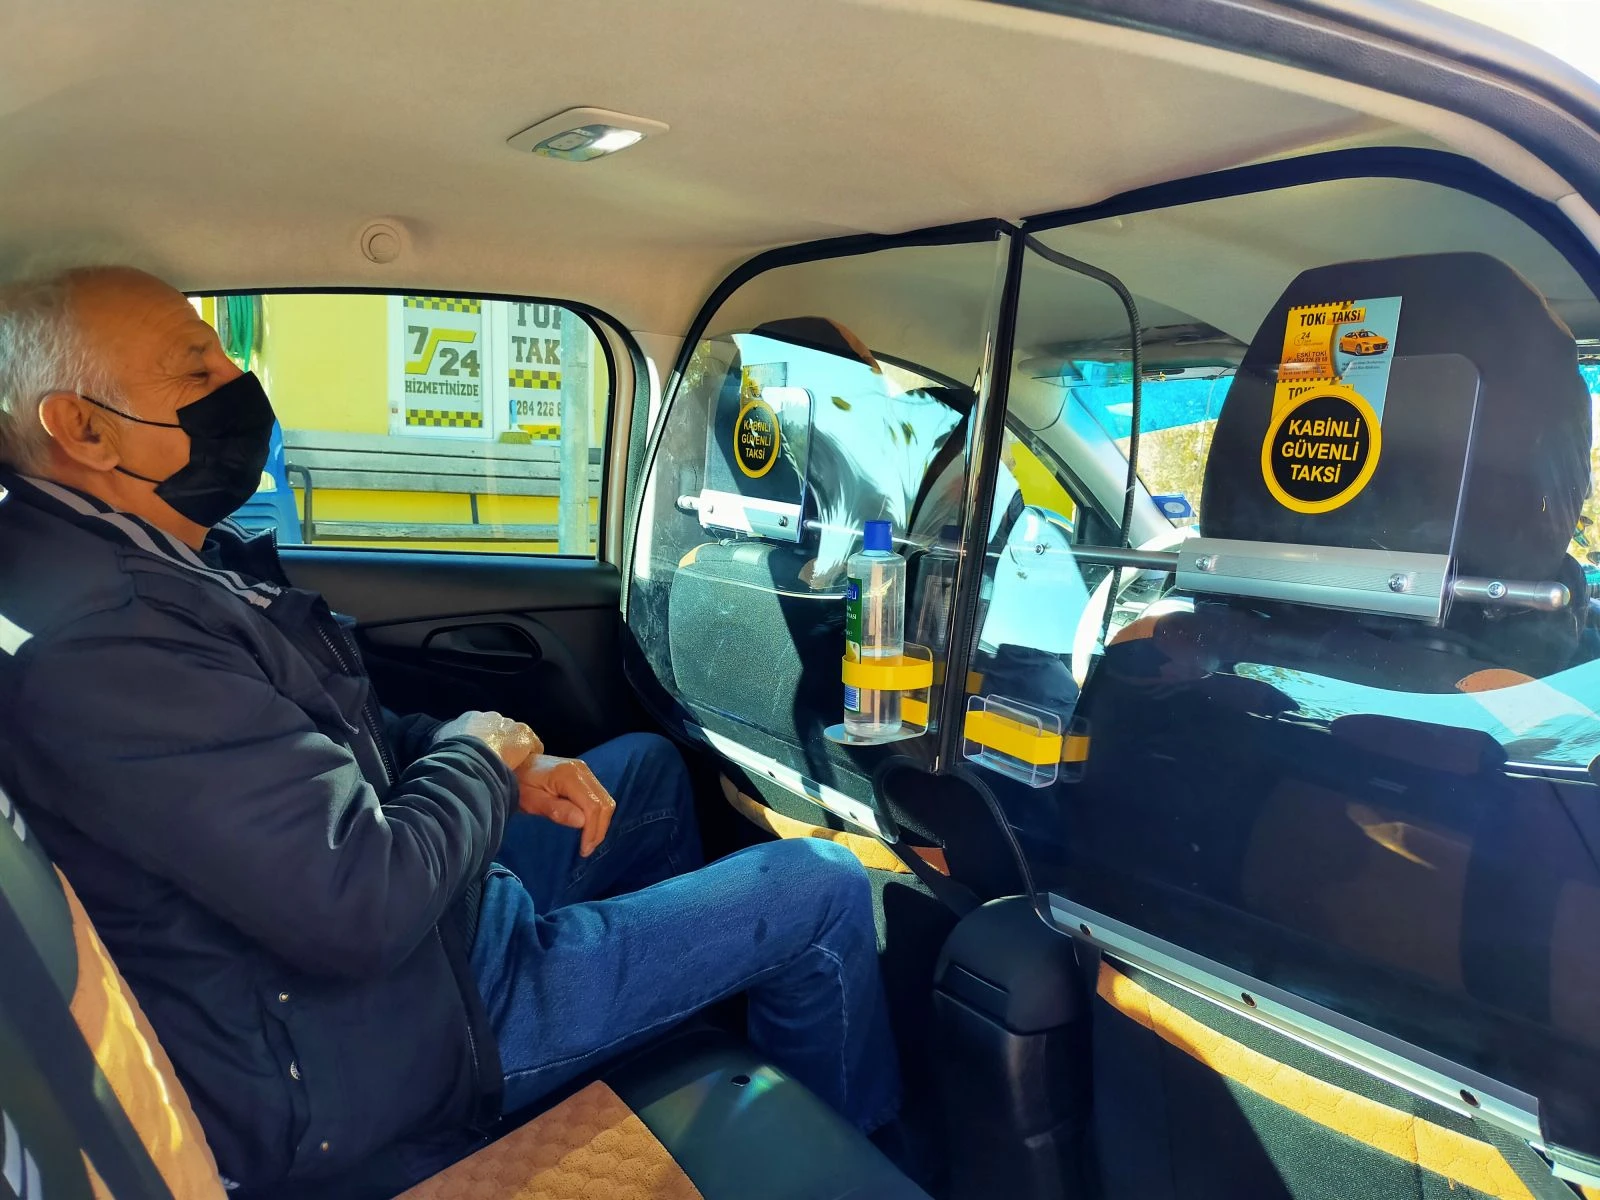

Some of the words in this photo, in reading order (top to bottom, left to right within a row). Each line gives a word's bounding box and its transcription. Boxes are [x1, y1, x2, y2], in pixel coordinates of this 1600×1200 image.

[408, 325, 429, 355] 7
[439, 347, 481, 377] 24
[405, 378, 479, 397] HİZMETİNİZDE
[1288, 386, 1315, 400] TO
[744, 420, 770, 432] KABİNLİ
[1288, 416, 1360, 438] KABİNLİ
[742, 432, 771, 446] GÜVENLİ
[745, 448, 765, 459] TAKSİ
[1281, 438, 1360, 461] GÜVENLİ
[1290, 463, 1342, 483] TAKSİ
